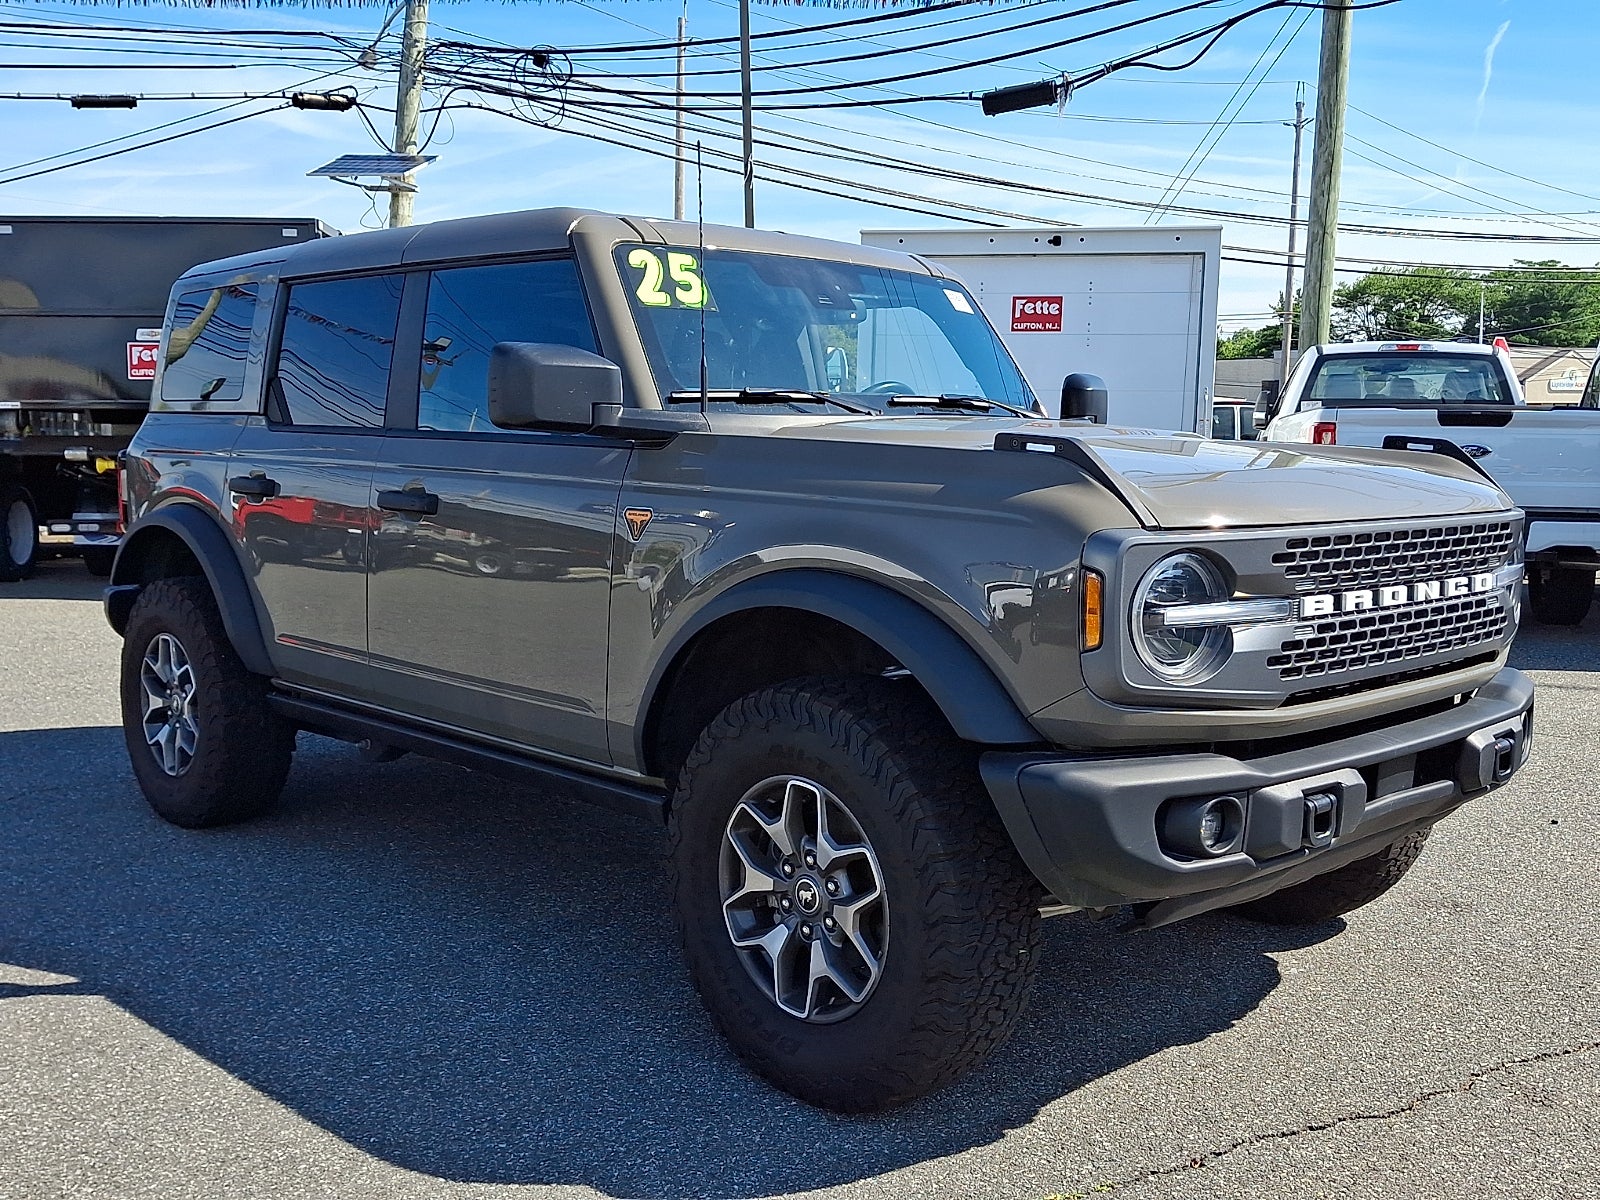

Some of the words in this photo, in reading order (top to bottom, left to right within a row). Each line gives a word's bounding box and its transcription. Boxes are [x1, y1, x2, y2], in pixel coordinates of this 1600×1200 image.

[628, 248, 708, 308] 25
[1015, 299, 1060, 318] Fette
[1013, 322, 1045, 330] CLIFTON,
[1046, 322, 1060, 330] N.J.
[1302, 573, 1494, 616] BRONCO
